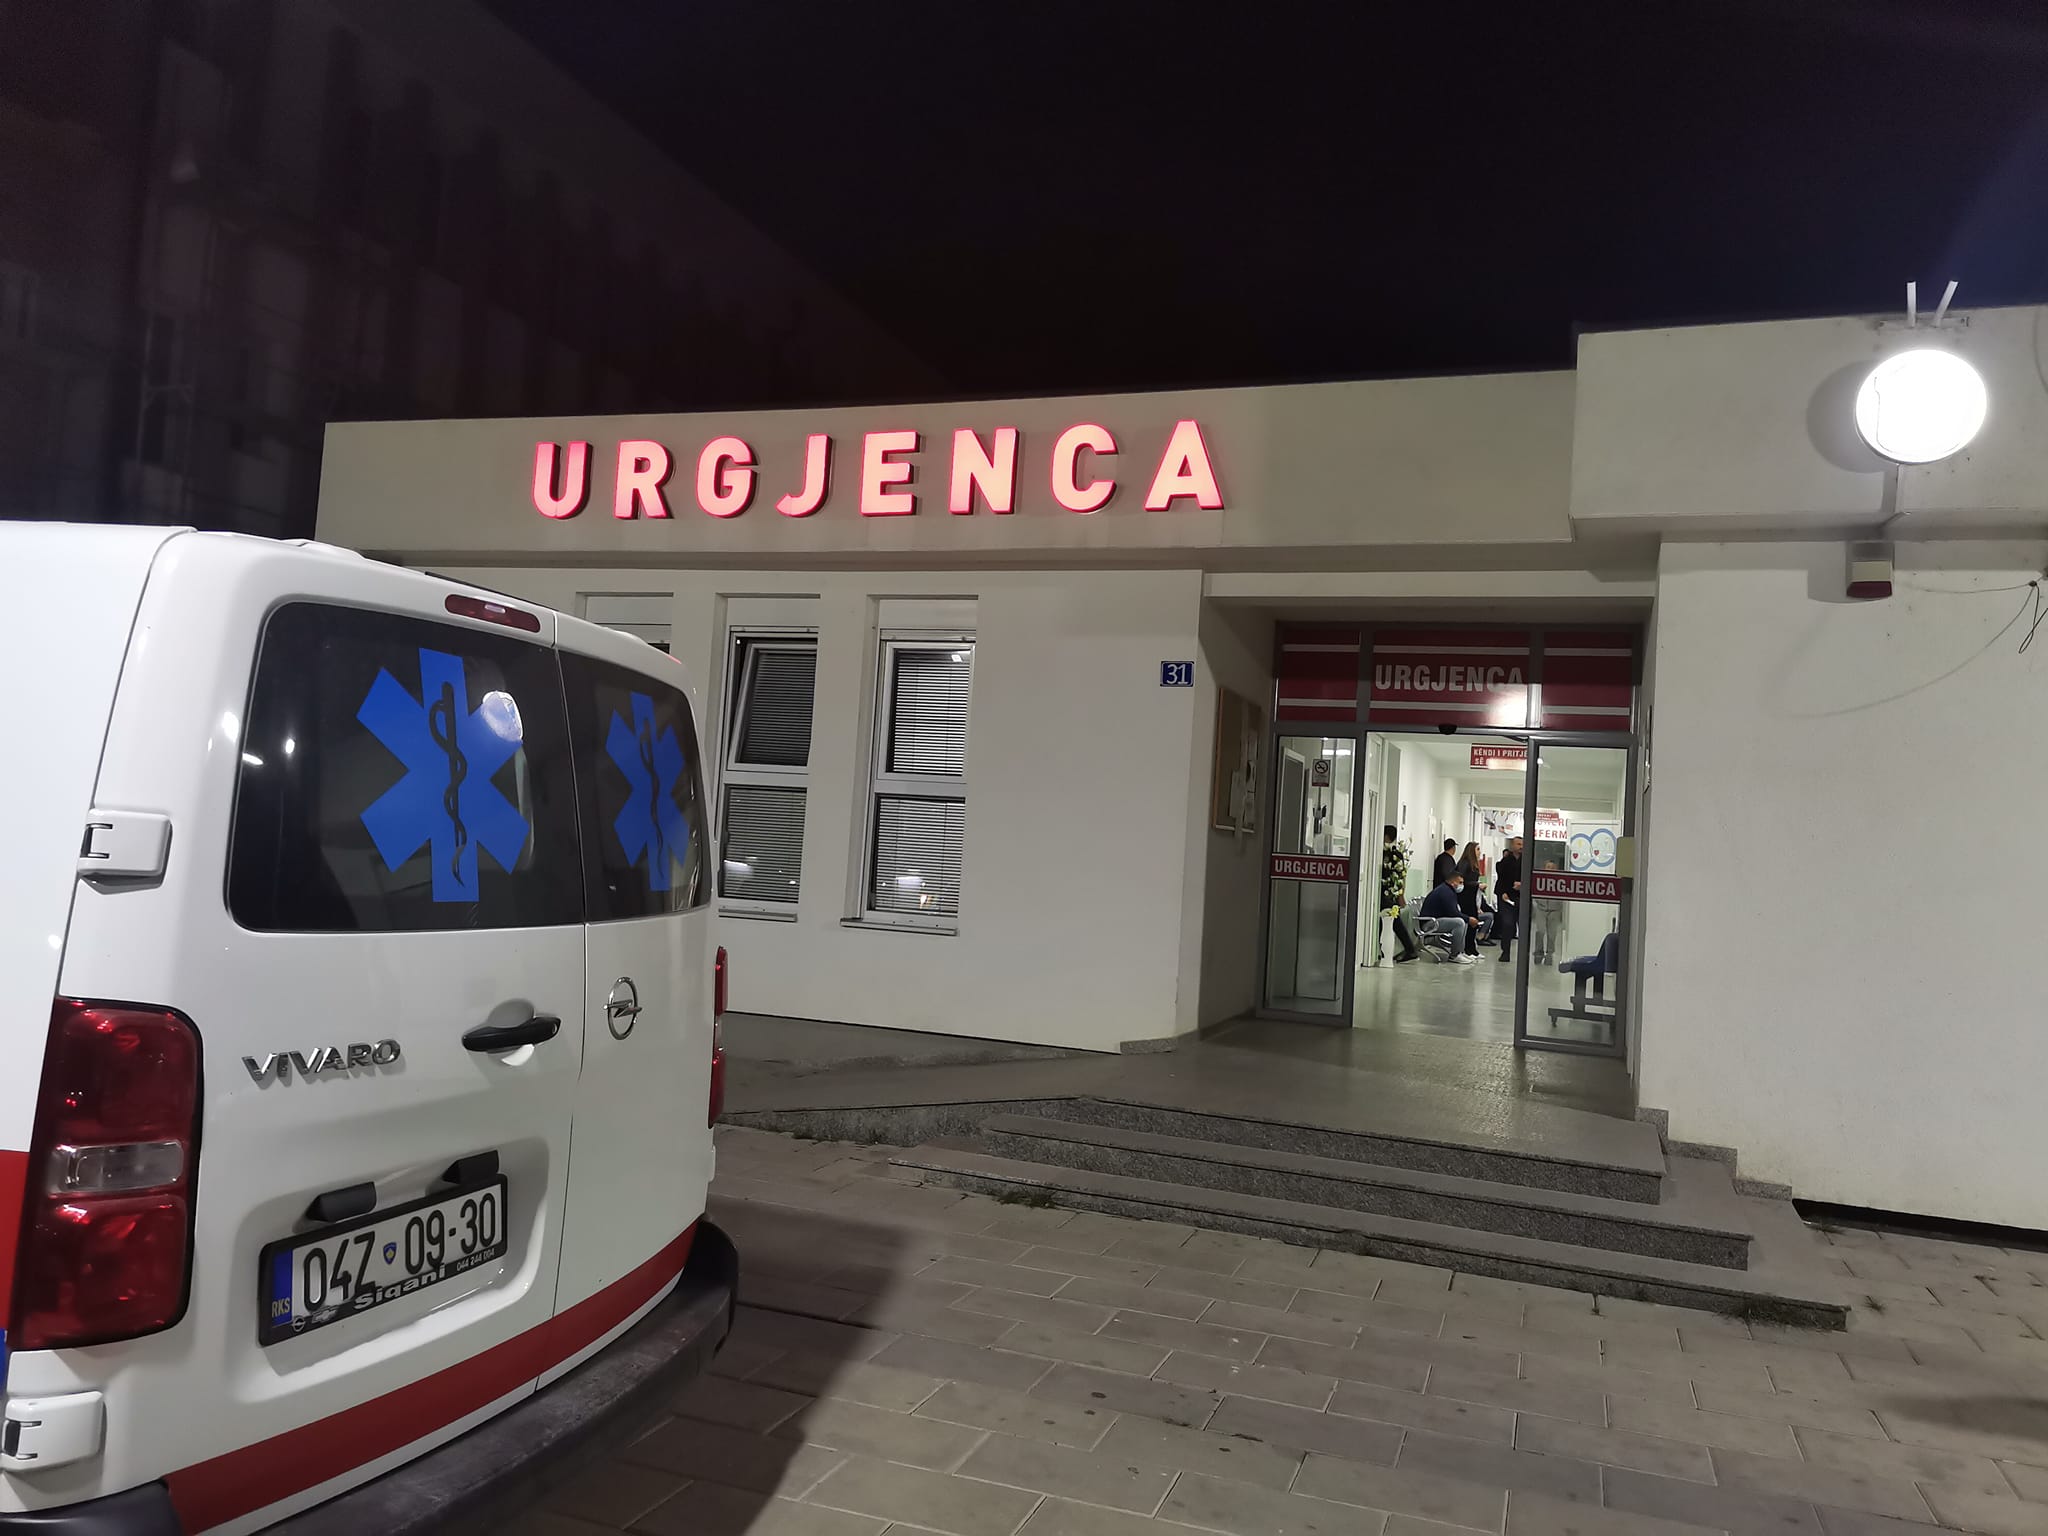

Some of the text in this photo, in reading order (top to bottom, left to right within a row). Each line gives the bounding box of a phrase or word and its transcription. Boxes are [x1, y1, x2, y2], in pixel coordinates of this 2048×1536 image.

[531, 419, 1224, 520] URGJENCA
[1165, 663, 1189, 685] 31
[1375, 664, 1525, 693] URGJENCA
[1274, 859, 1345, 876] URGJENCA
[1536, 877, 1616, 896] URGJENCA
[242, 1038, 401, 1081] VIVARO
[405, 1192, 496, 1274] 09-30
[272, 1297, 291, 1319] RKS
